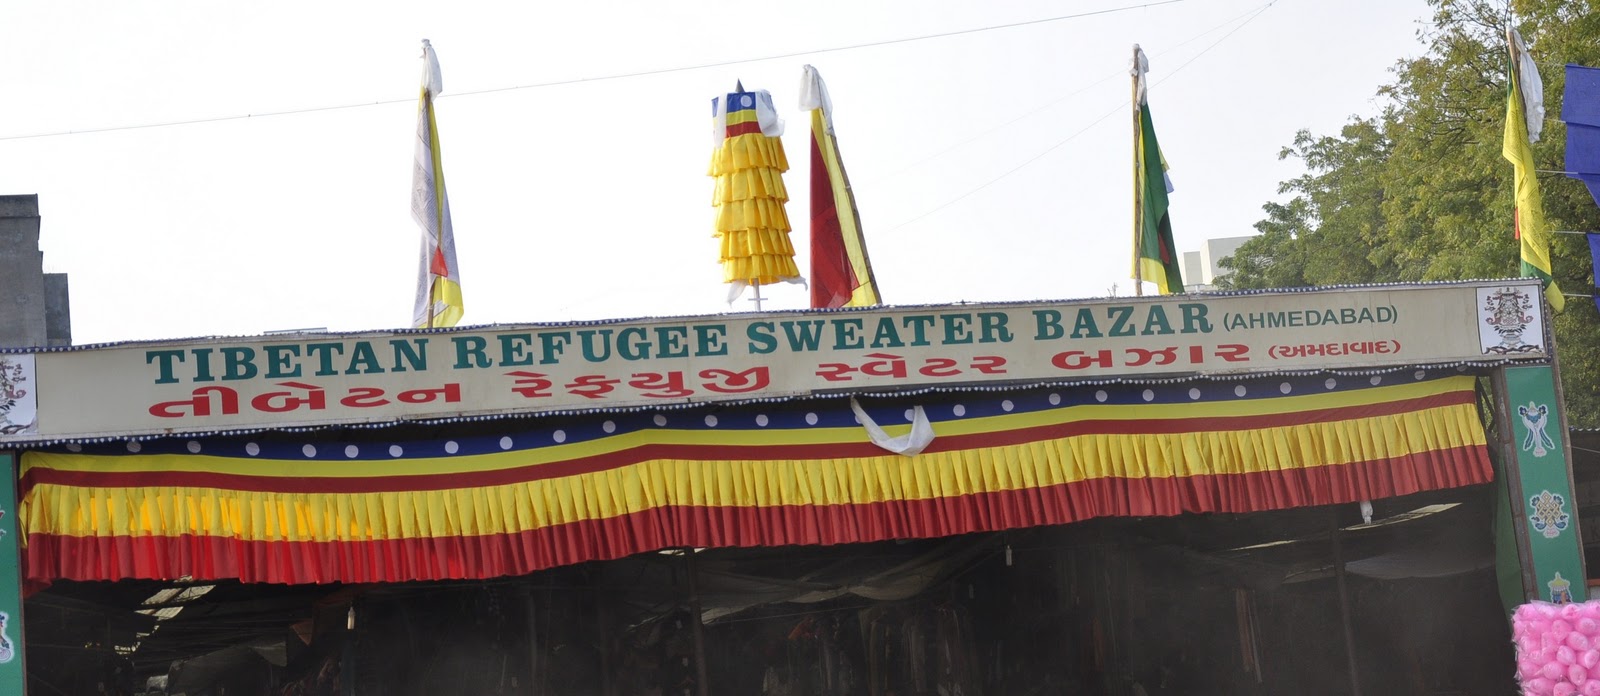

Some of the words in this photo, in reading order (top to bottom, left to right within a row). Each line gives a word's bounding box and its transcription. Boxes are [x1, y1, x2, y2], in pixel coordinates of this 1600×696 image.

[146, 337, 430, 385] TIBETAN
[453, 323, 729, 370] REFUGEE
[747, 311, 1014, 355] SWEATER
[1034, 303, 1214, 340] BAZAR
[1223, 305, 1398, 332] (AHMEDABAD)
[149, 381, 462, 418] તીબેટન
[815, 352, 1008, 382] સ્વેટર
[1051, 344, 1250, 370] બઝાર
[1268, 340, 1401, 360] (અમદાવાદ)
